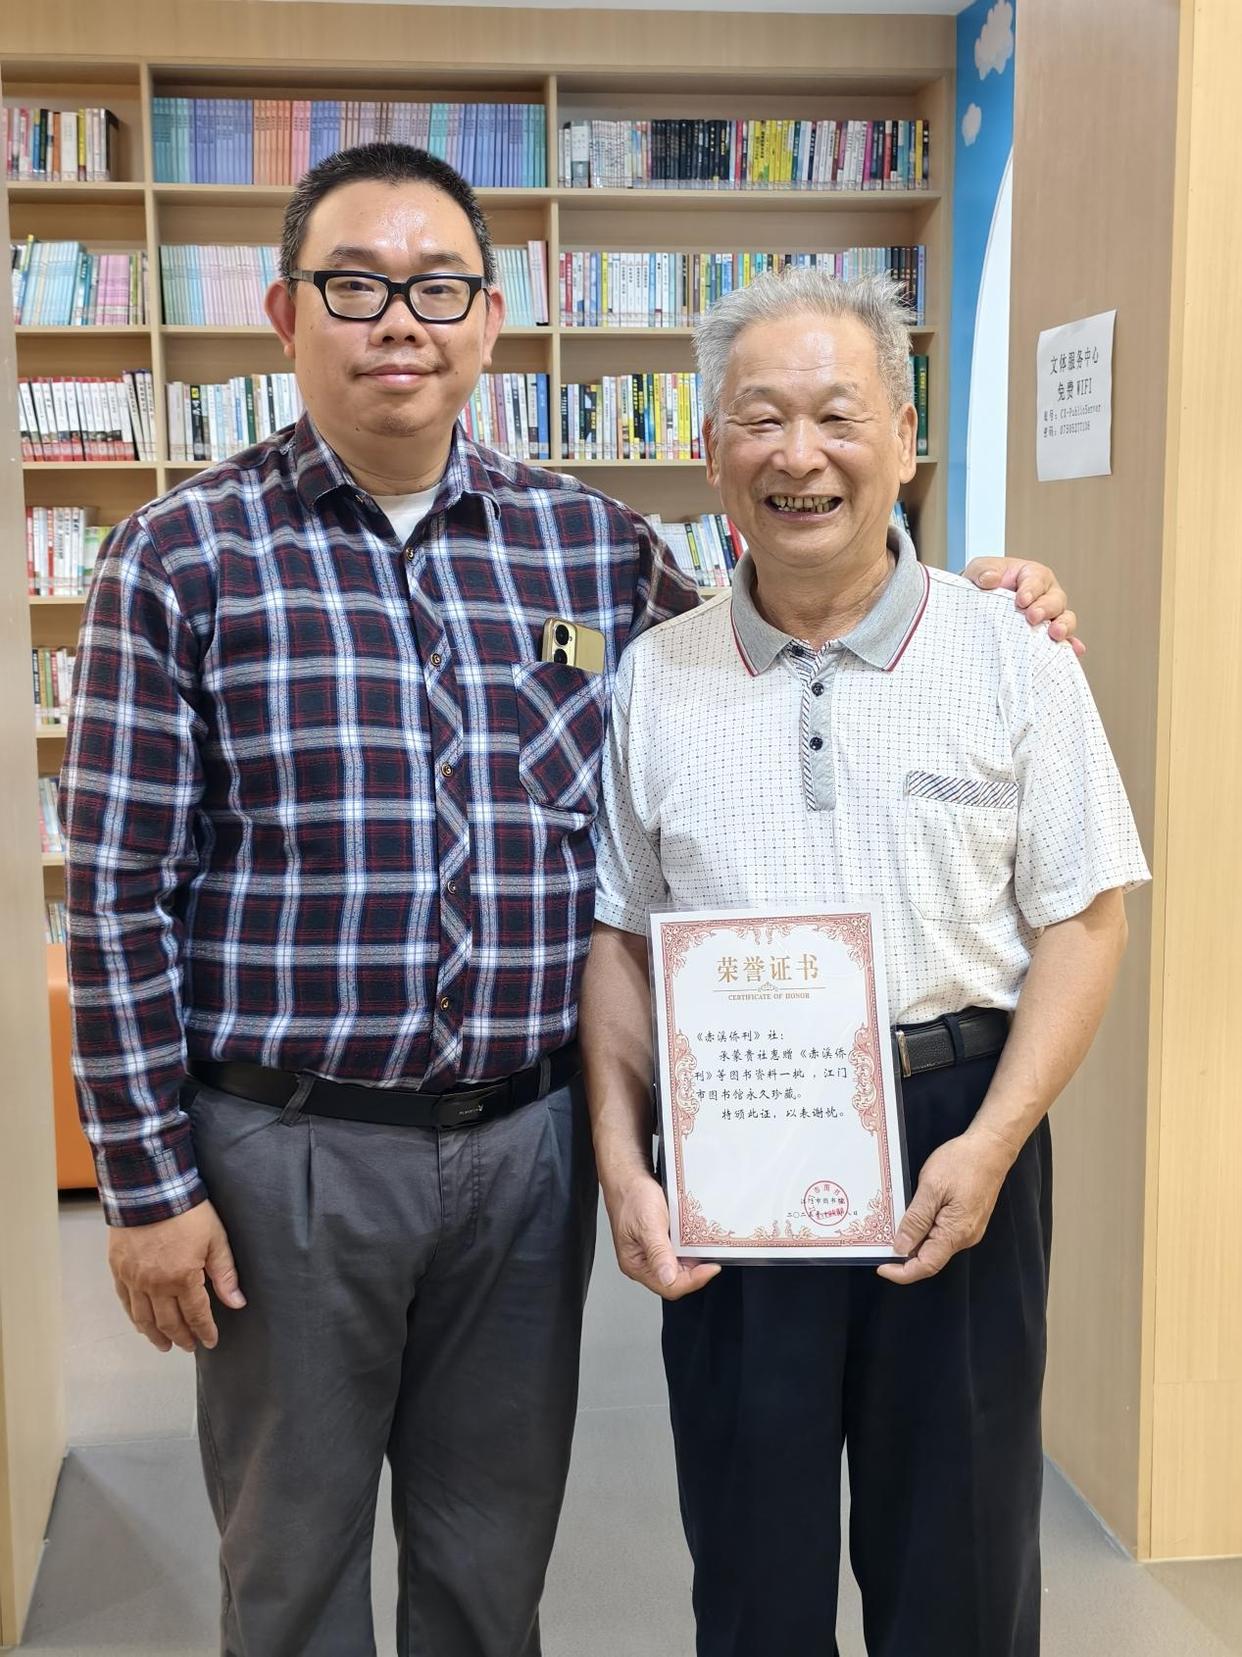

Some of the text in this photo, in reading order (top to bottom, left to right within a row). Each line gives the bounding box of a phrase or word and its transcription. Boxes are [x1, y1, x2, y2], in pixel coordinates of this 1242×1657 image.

[1050, 346, 1098, 375] 文体服务中心
[717, 953, 819, 983] 荣誉证书
[728, 993, 771, 1001] CERTIFICATE
[773, 992, 783, 1000] OF
[696, 1087, 802, 1101] 市图书馆永久珍藏。
